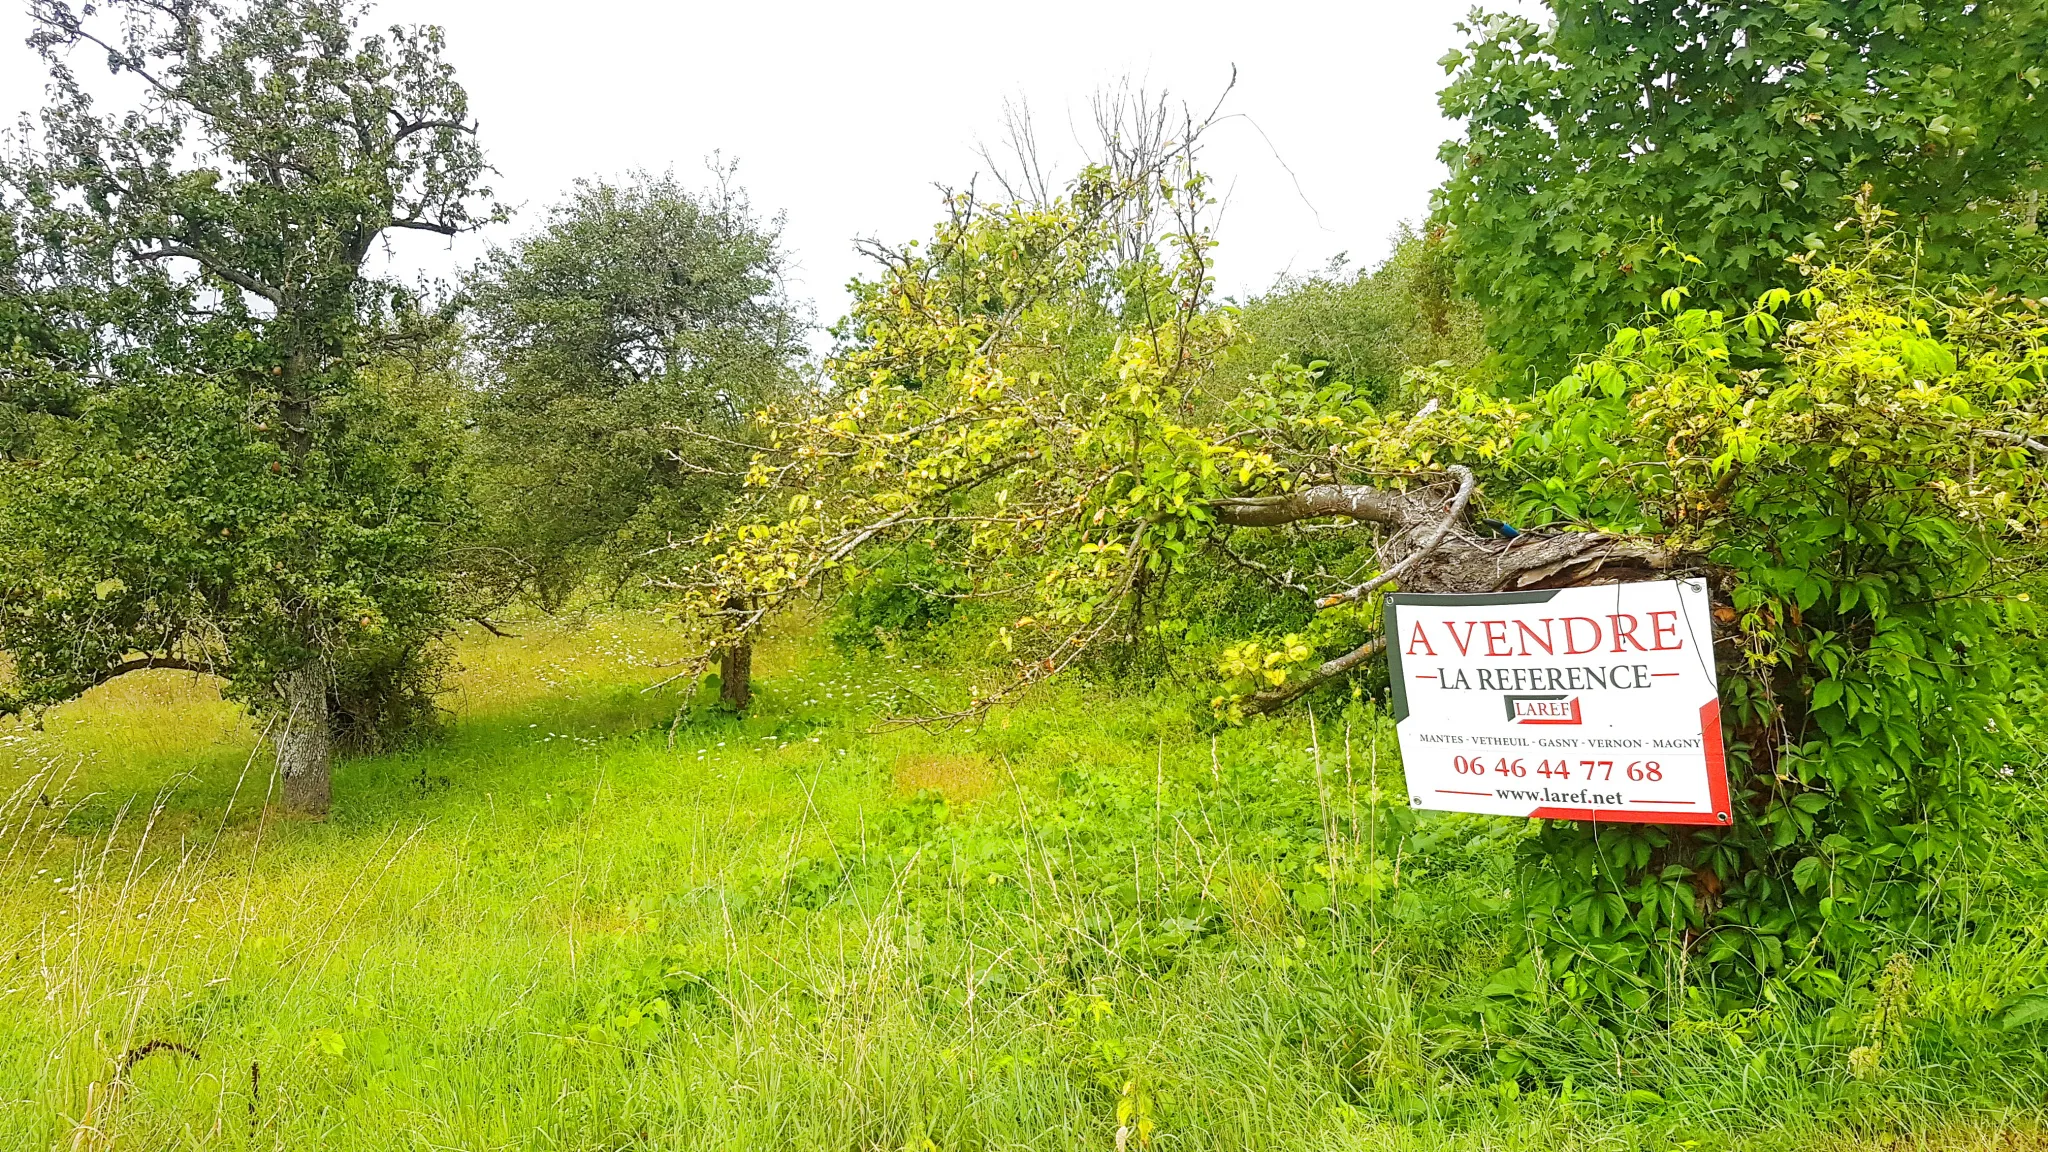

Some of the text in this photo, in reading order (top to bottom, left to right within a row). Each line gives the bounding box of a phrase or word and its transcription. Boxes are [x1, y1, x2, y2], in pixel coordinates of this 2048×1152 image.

[1406, 611, 1683, 657] A VENDRE
[1437, 664, 1652, 691] LA REFERENCE
[1515, 702, 1570, 716] LAREF
[1420, 733, 1701, 748] MANTES VETHEUIL GASNY VERNON MAGNY
[1453, 755, 1663, 781] 06 46 44 77 68
[1496, 788, 1623, 805] www.laref.net
